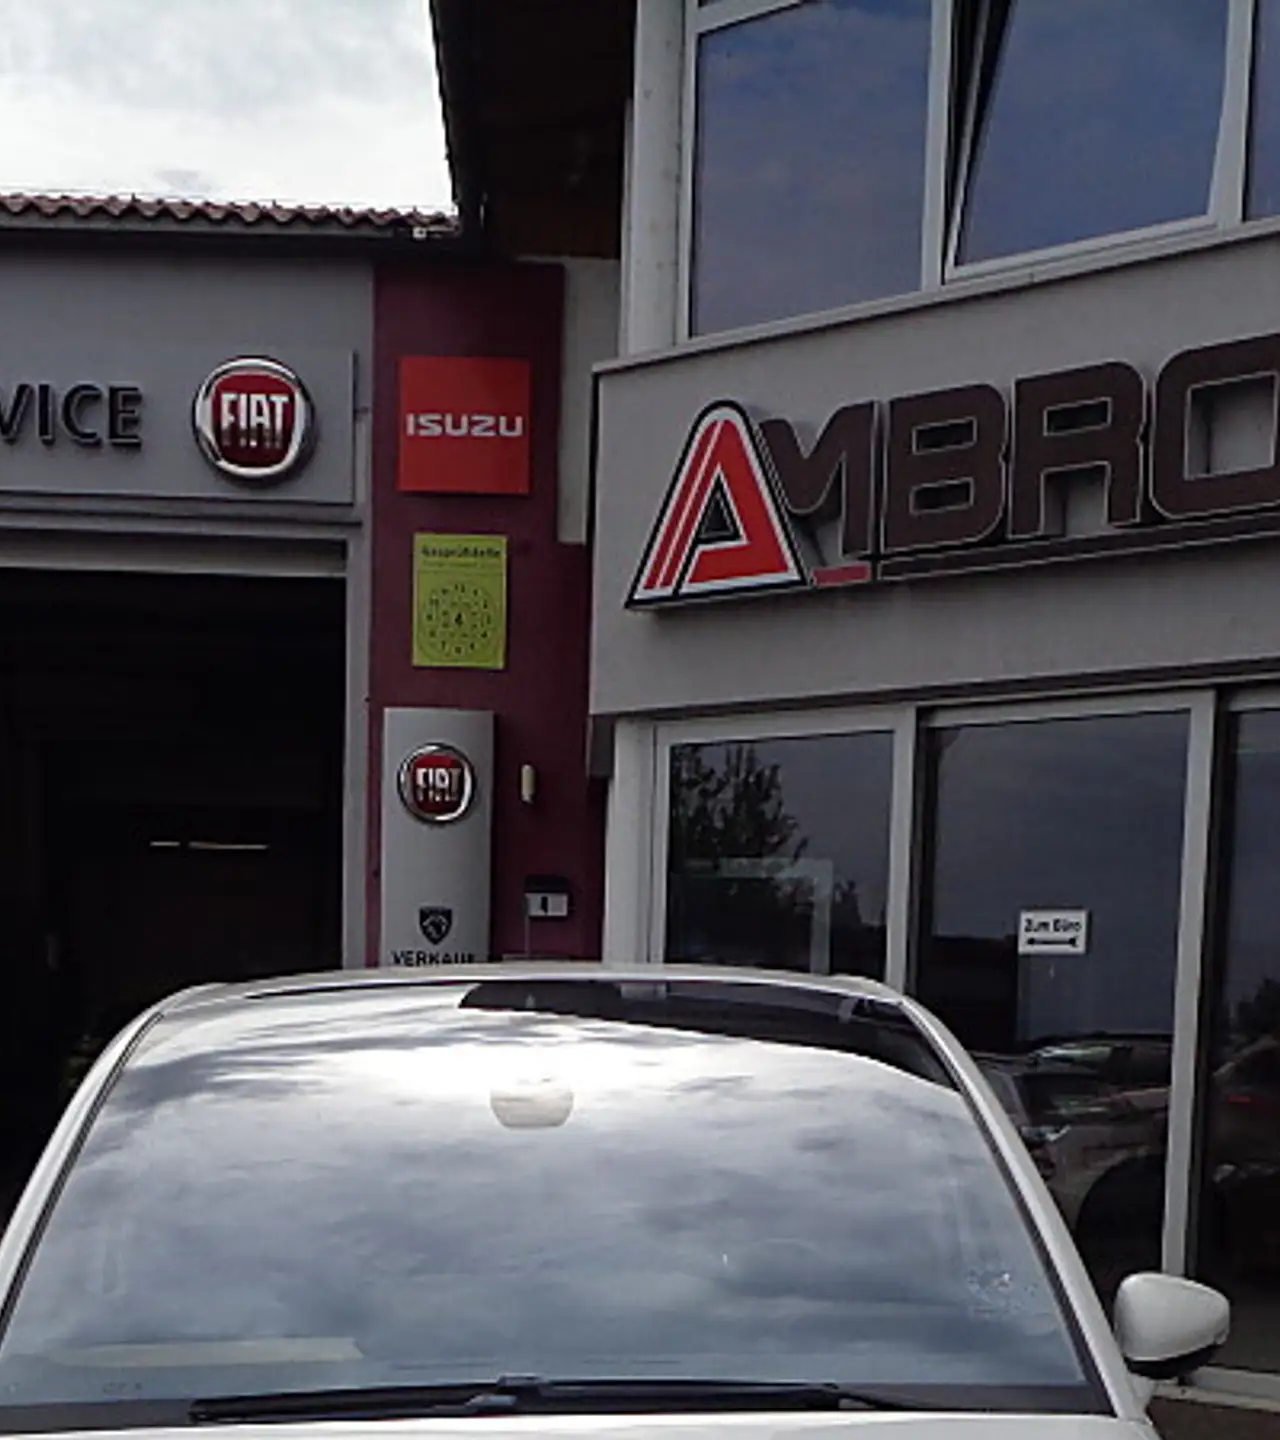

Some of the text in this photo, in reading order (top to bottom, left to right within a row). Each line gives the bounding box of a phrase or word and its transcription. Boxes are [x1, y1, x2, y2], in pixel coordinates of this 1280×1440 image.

[220, 391, 292, 446] FIAT
[406, 412, 524, 438] ISUZU
[415, 766, 462, 799] FIAT
[1024, 917, 1082, 933] Zum Büro
